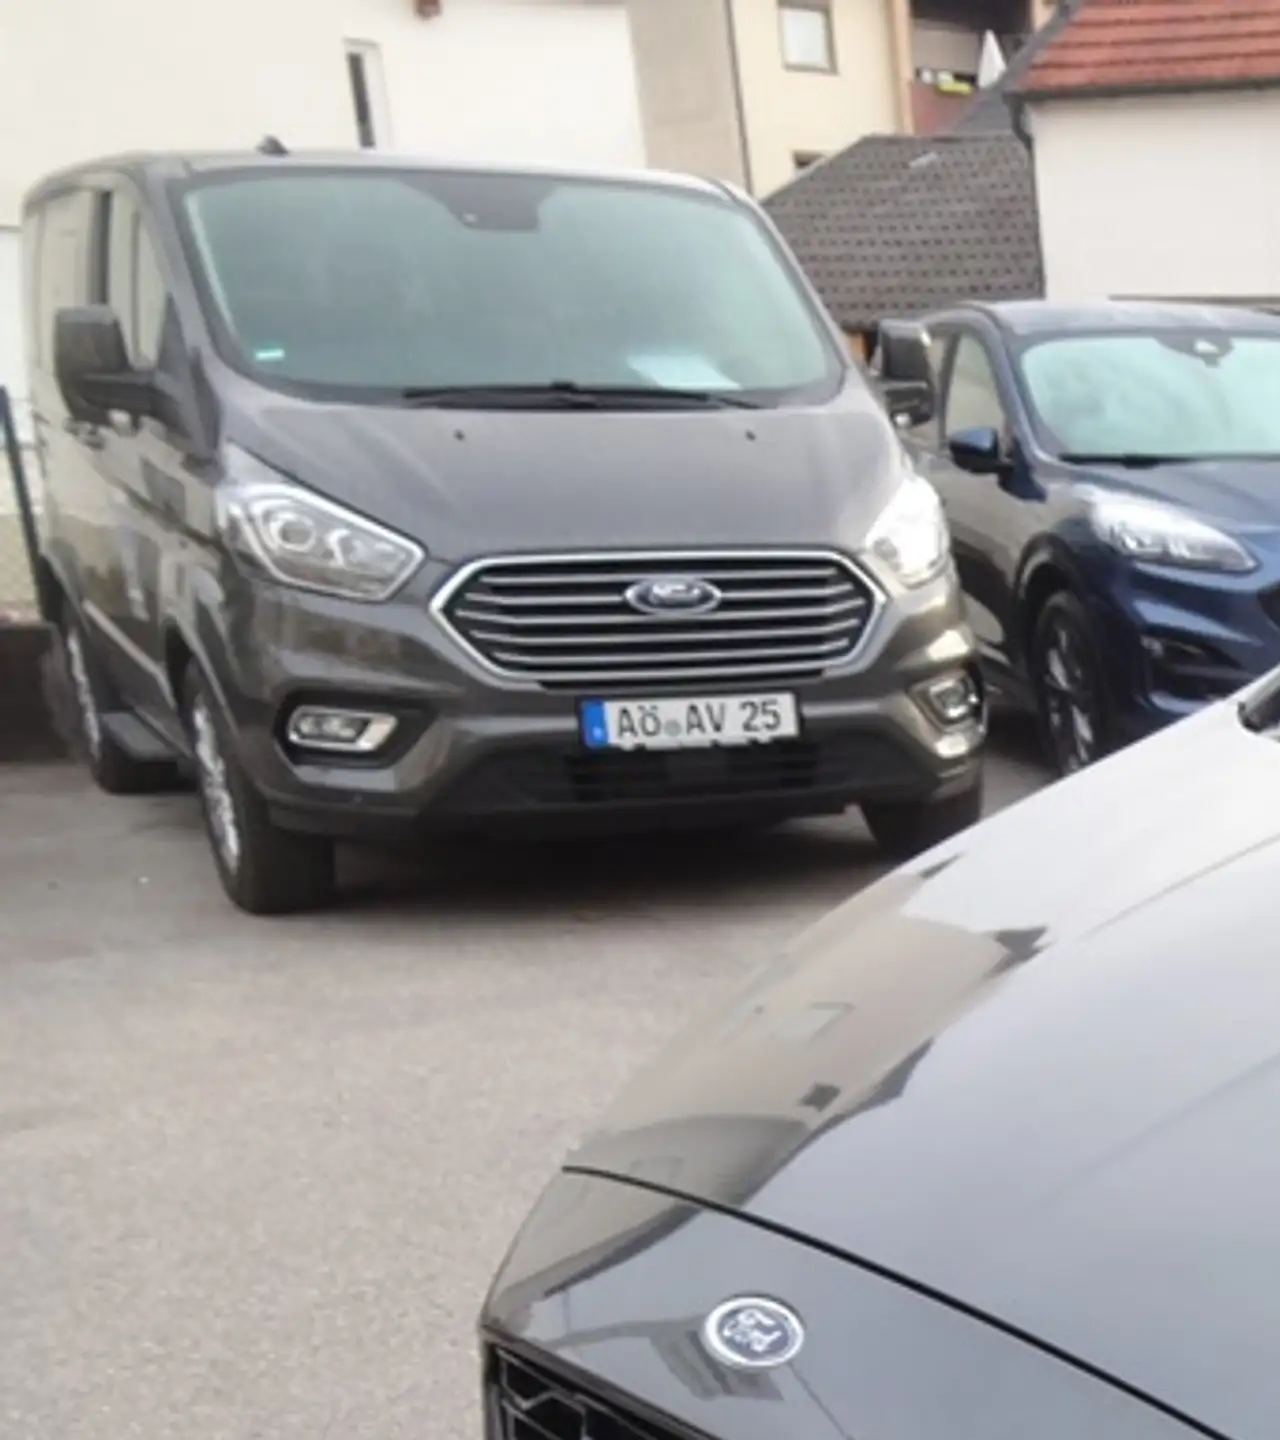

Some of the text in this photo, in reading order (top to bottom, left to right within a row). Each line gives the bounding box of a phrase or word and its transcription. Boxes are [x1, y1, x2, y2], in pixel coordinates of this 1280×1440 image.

[617, 700, 782, 738] AÖ AV 25
